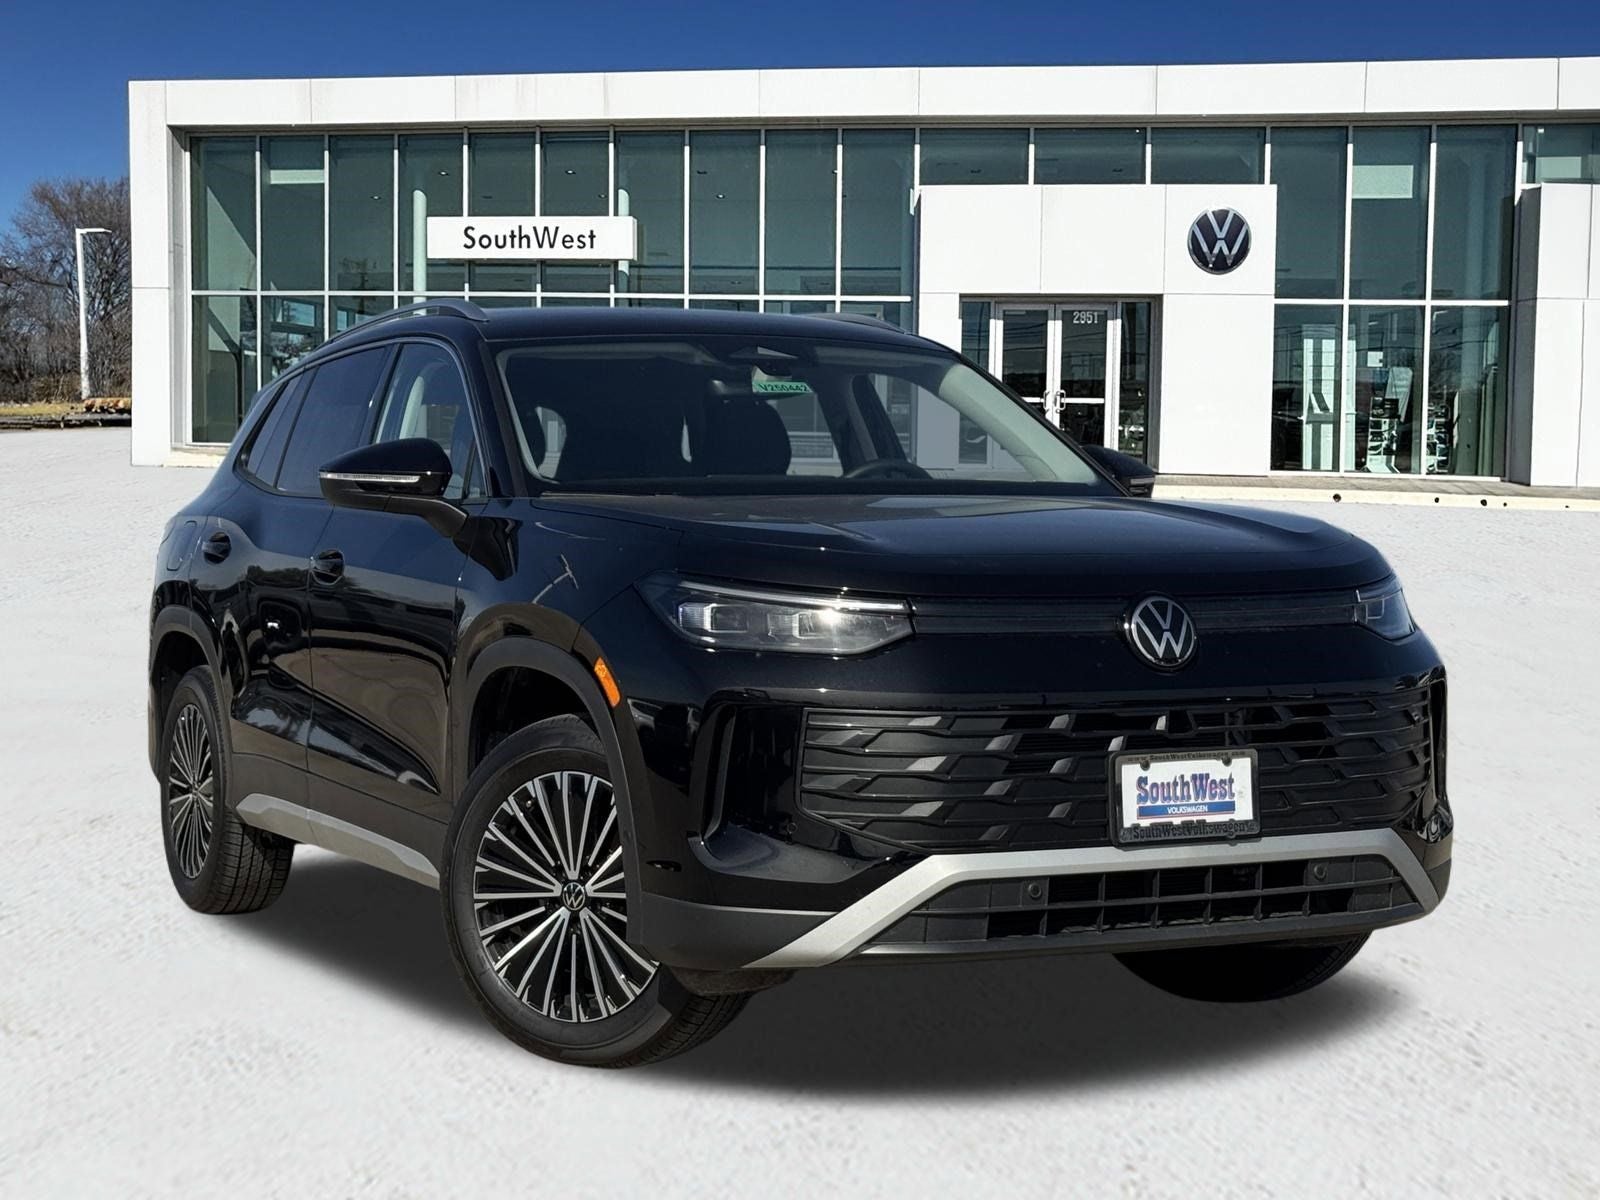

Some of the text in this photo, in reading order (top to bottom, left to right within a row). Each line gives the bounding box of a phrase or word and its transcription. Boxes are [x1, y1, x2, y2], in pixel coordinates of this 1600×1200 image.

[463, 224, 596, 249] SouthWest
[1190, 209, 1249, 268] VW
[1073, 311, 1098, 324] 2951
[1133, 599, 1191, 660] VW
[1136, 772, 1235, 804] SouthWest
[1167, 805, 1208, 814] VOLKSWAGEN
